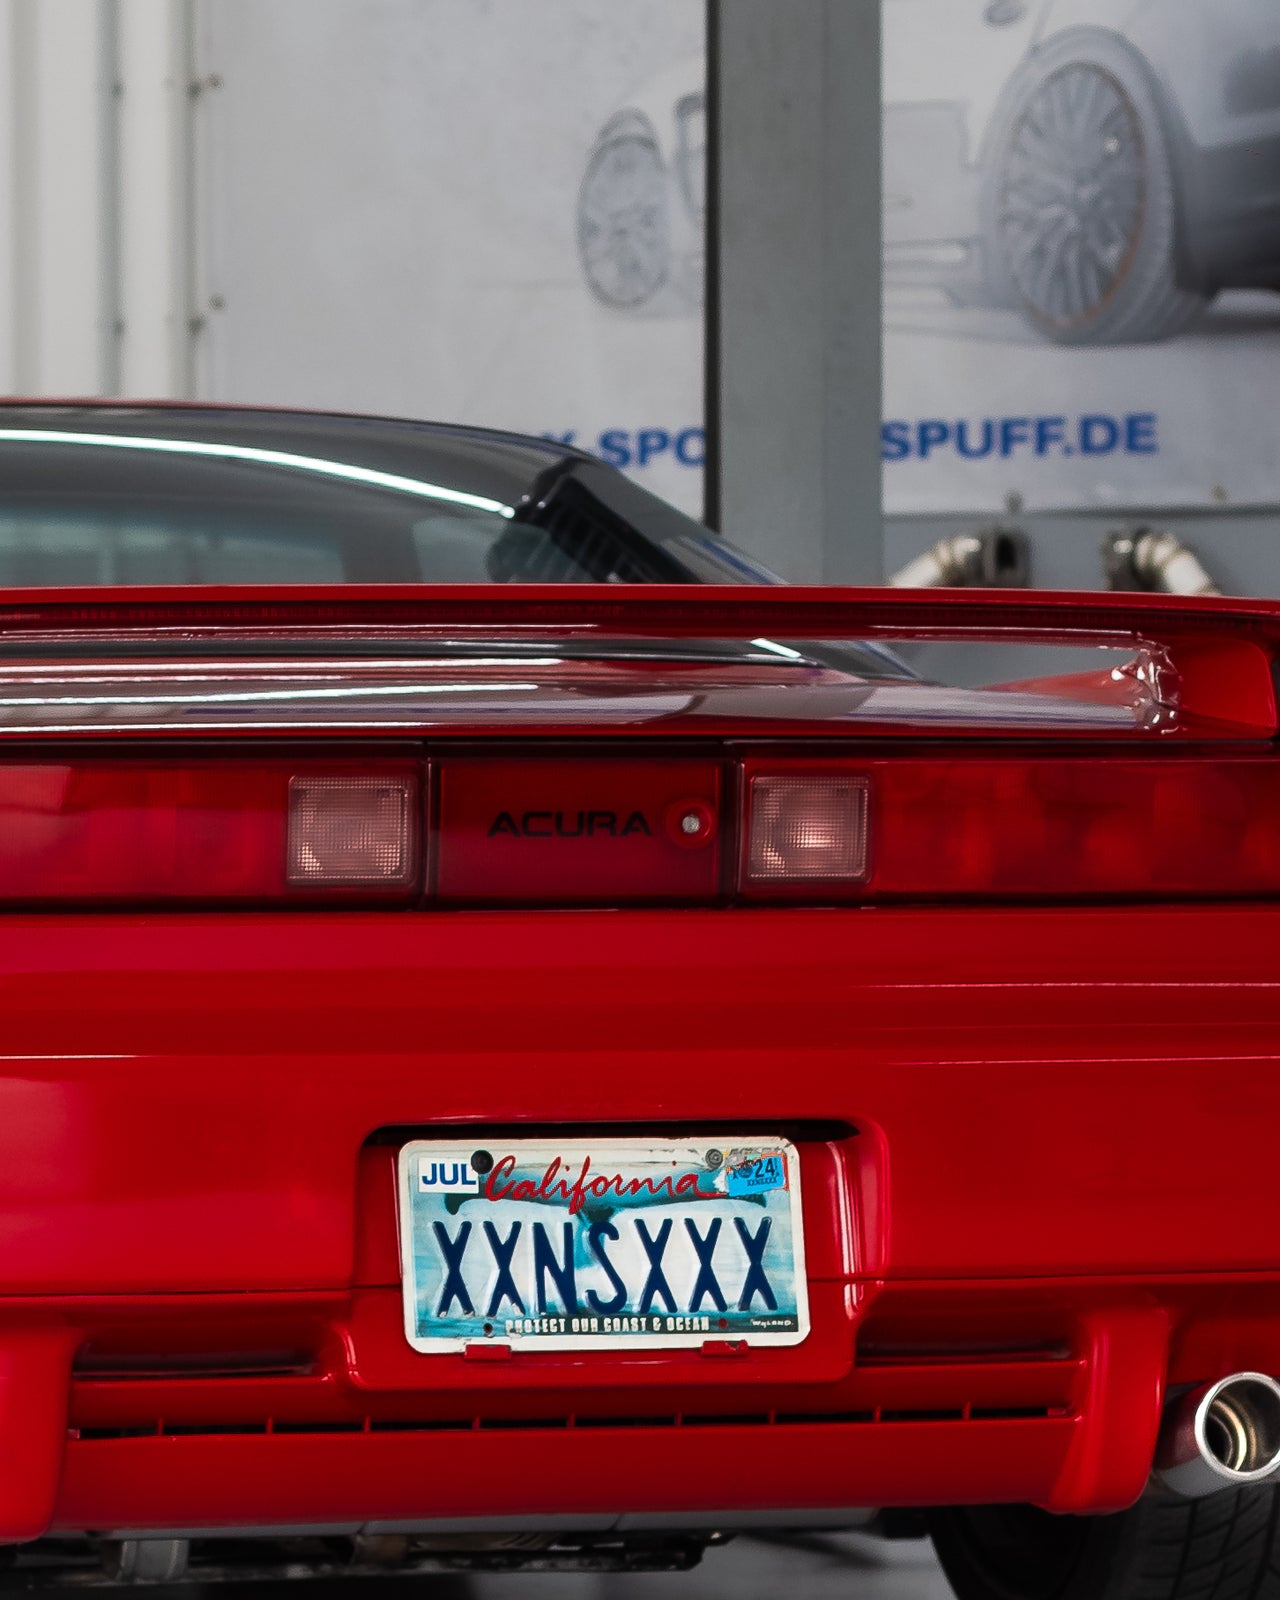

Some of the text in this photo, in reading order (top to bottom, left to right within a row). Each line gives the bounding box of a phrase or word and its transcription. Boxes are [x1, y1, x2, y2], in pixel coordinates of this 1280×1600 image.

[487, 811, 652, 838] ACURA
[421, 1162, 478, 1186] JUL
[484, 1155, 728, 1215] California
[431, 1217, 779, 1317] XXNSXXX
[505, 1316, 711, 1334] PROTECT OUR COAST & OCEAN
